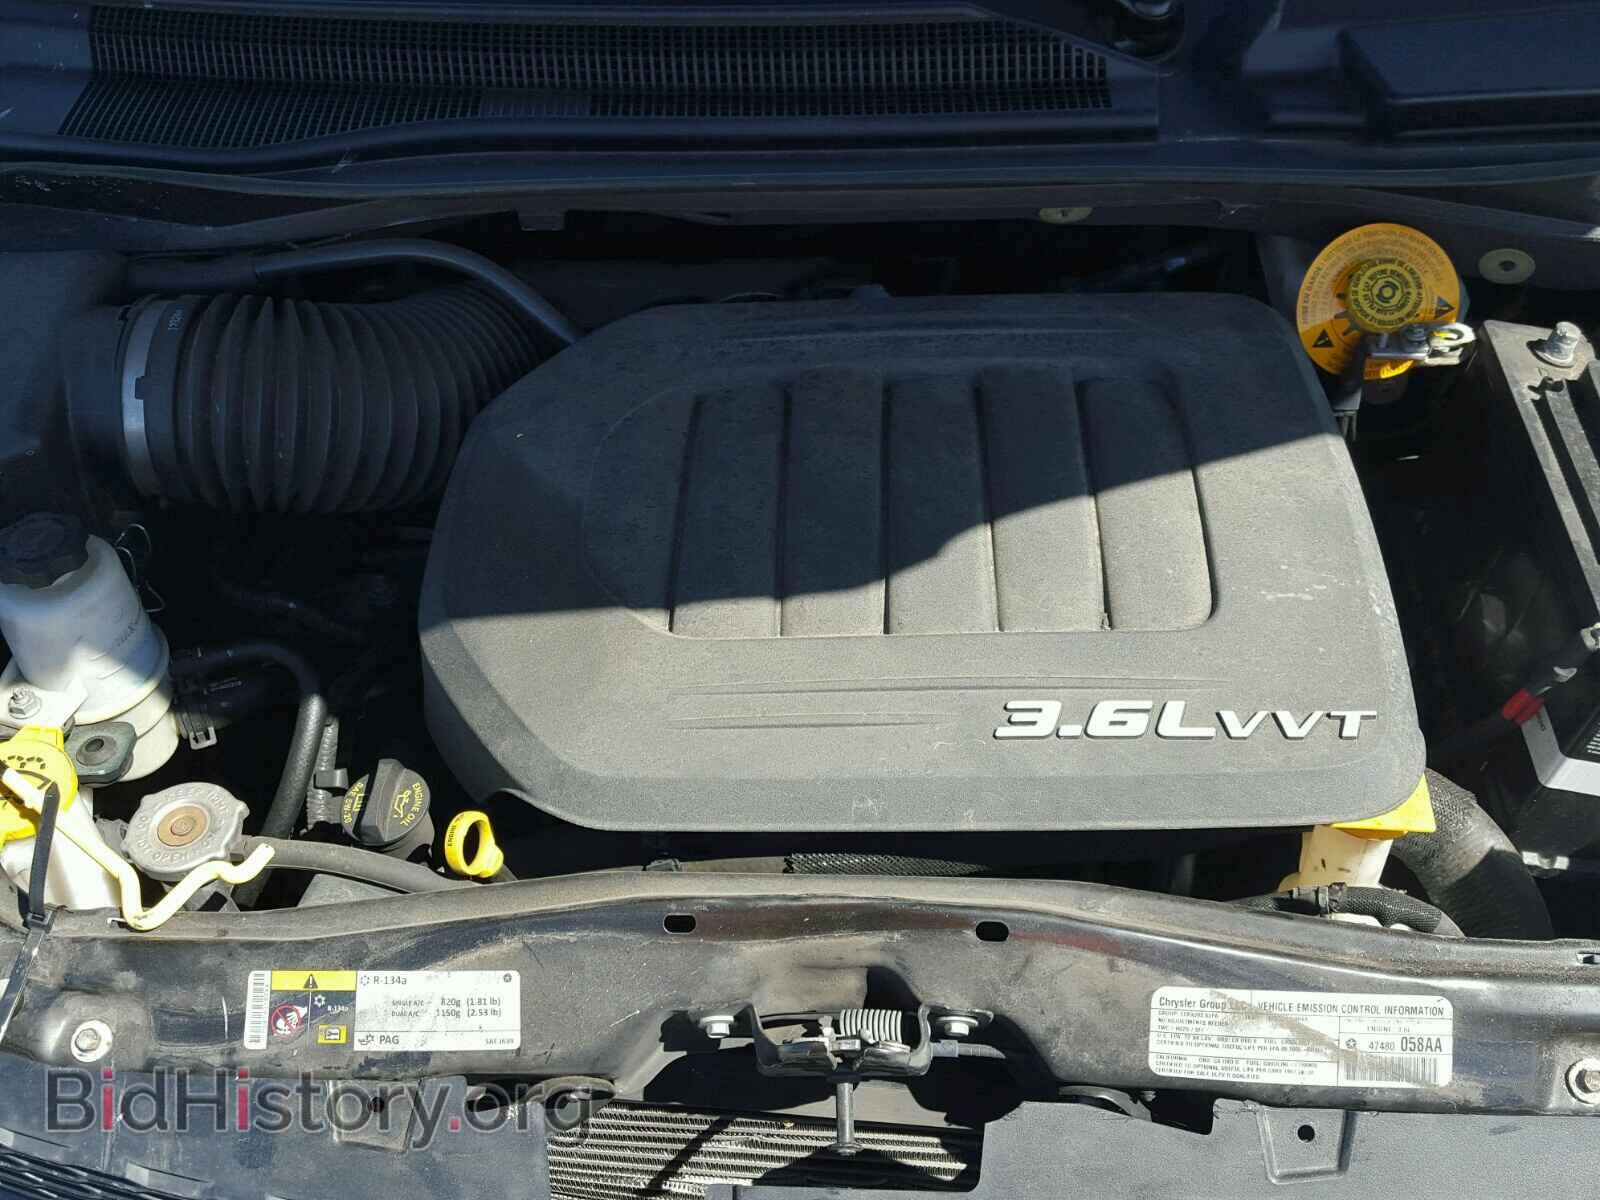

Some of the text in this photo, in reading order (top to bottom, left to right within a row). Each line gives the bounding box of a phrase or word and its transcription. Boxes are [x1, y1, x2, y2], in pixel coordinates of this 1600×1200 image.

[993, 700, 1377, 740] 3.6L VVT
[399, 781, 424, 827] ENGINE OIL
[373, 976, 407, 985] R-134a
[1159, 997, 1196, 1009] Chrysler
[1199, 999, 1227, 1011] Group
[1257, 1001, 1444, 1017] VEHICLE EMISSION CONTROL INFORMATION
[380, 1035, 400, 1045] PAG
[1401, 1037, 1442, 1052] 058AA
